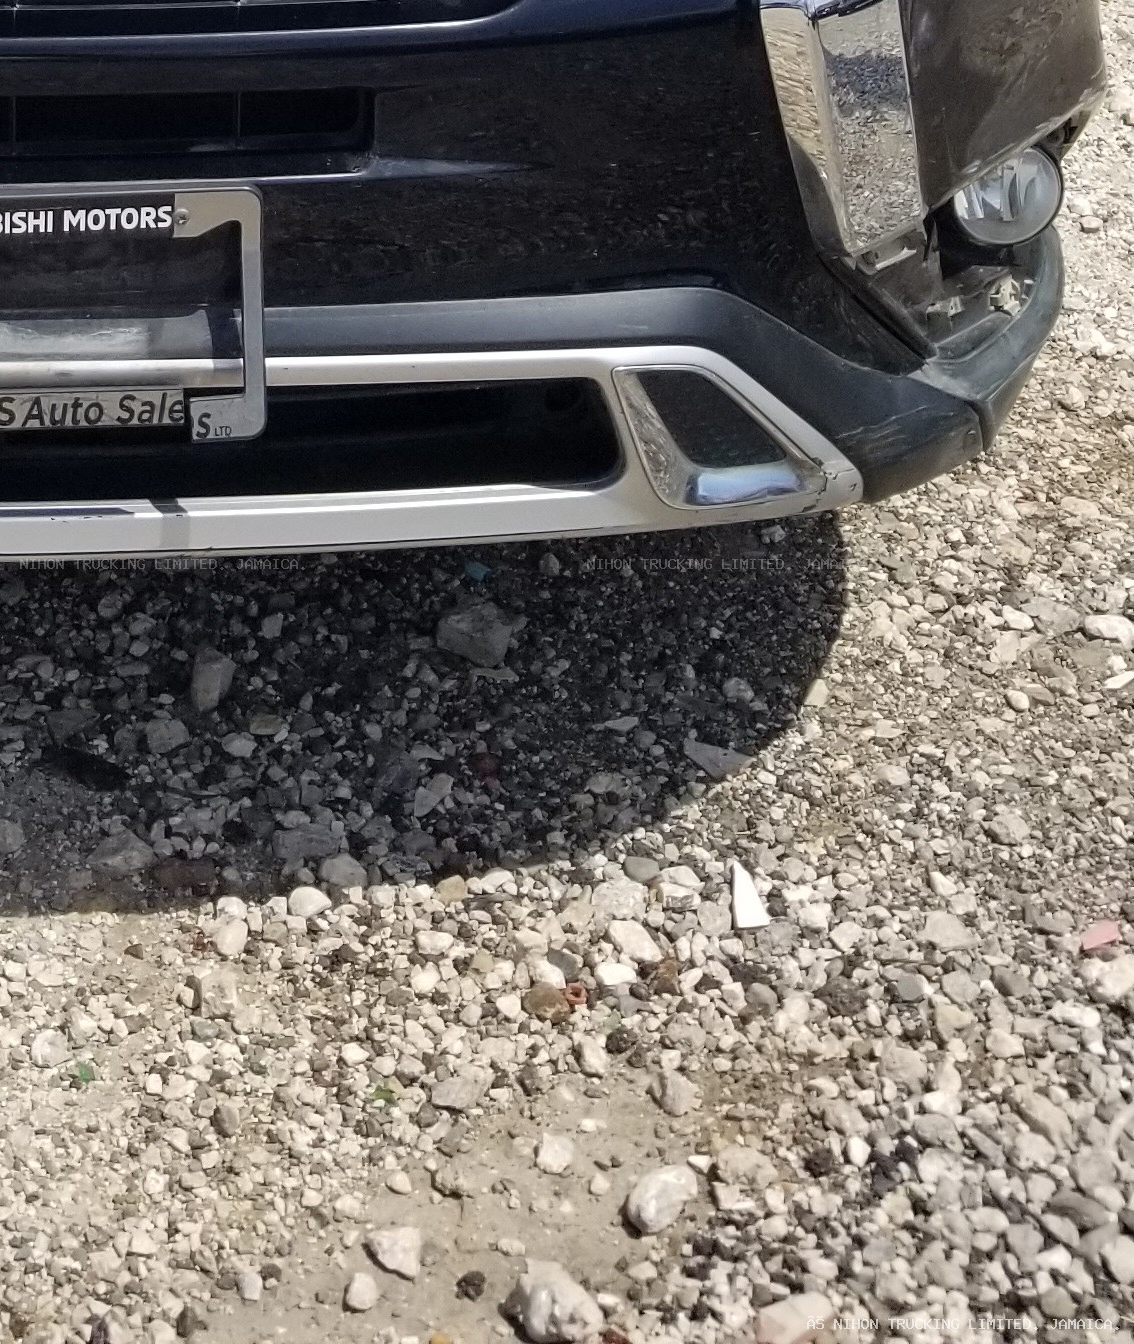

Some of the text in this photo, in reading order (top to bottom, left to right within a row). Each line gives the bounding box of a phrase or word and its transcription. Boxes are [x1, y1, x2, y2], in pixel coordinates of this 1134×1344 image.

[64, 205, 173, 231] MOTORS
[20, 397, 105, 428] Auto
[214, 425, 233, 438] LTD
